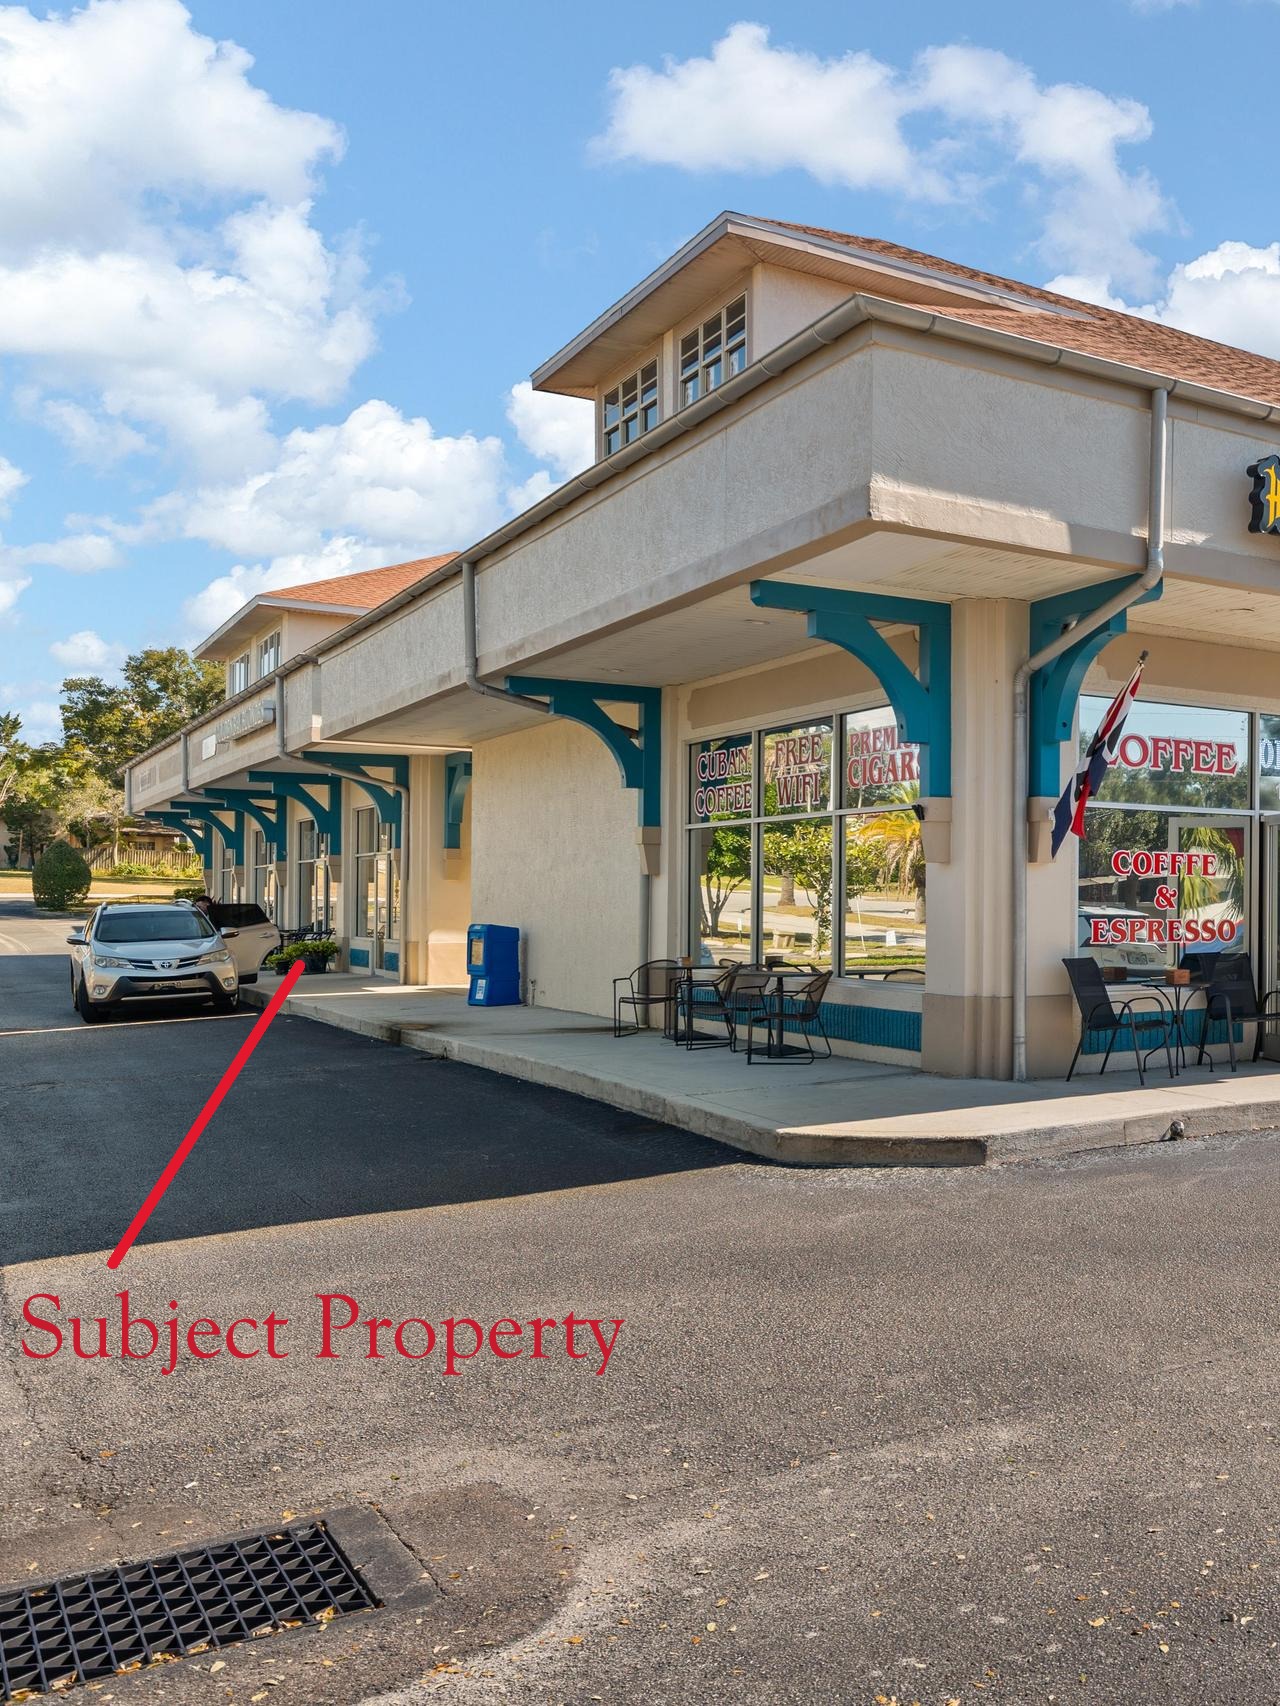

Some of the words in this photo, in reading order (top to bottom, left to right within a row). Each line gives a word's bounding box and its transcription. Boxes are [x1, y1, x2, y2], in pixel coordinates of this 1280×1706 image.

[773, 732, 822, 770] FREE
[849, 726, 920, 757] PREM
[1108, 734, 1238, 777] OFFEE
[697, 746, 752, 781] CUBAN
[694, 782, 752, 816] COFFEE
[776, 772, 821, 807] WIFI
[1154, 884, 1178, 910] &
[1090, 918, 1237, 944] ESPRESSO
